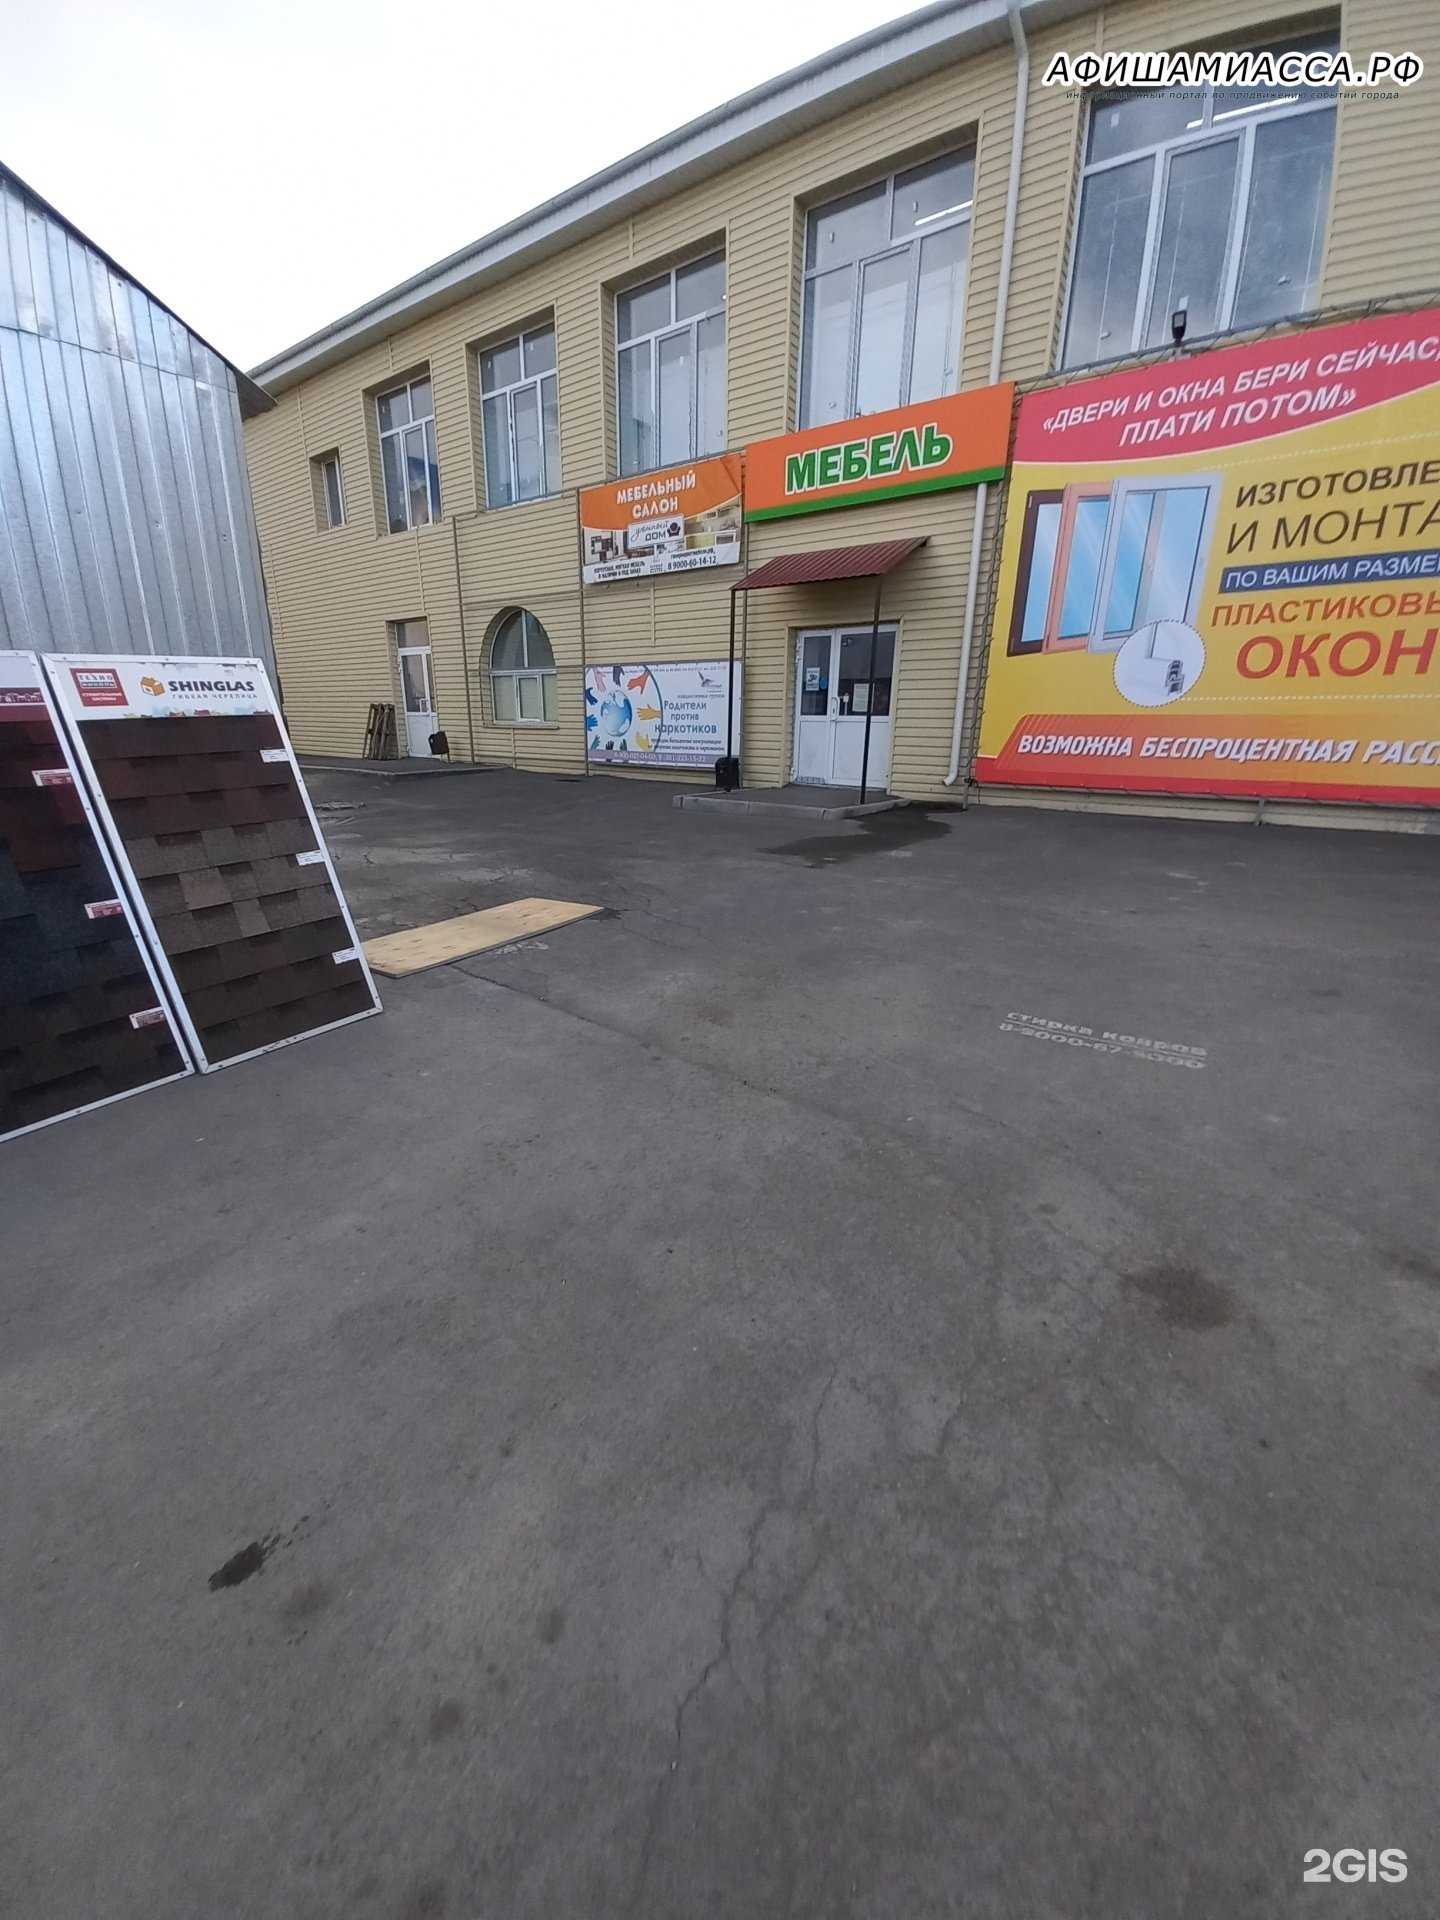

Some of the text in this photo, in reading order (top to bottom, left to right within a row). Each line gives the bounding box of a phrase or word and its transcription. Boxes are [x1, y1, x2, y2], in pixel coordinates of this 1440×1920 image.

[1043, 399, 1130, 433] «ДВЕРИ
[1134, 391, 1151, 413] И
[1158, 376, 1226, 409] ОКНА
[1232, 358, 1310, 394] БЕРИ
[1119, 383, 1357, 447] ПЛАТИ ПОТОМ»
[785, 423, 953, 495] МЕБЕЛЬ
[616, 469, 697, 505] МЕБЕЛЬНЫЙ
[632, 495, 679, 519] САЛОН
[1226, 520, 1259, 554] И
[1225, 553, 1440, 589] ПО ВАШИМ РАЗМЕ
[1236, 628, 1439, 680] ОКОН
[168, 681, 255, 692] SHINGLAS
[664, 700, 707, 711] Родители
[670, 713, 699, 722] против
[654, 722, 717, 736] наркотиков
[1017, 734, 1440, 766] ВОЗМОЖНА БЕСПРОЦЕНТНАЯ РАСС
